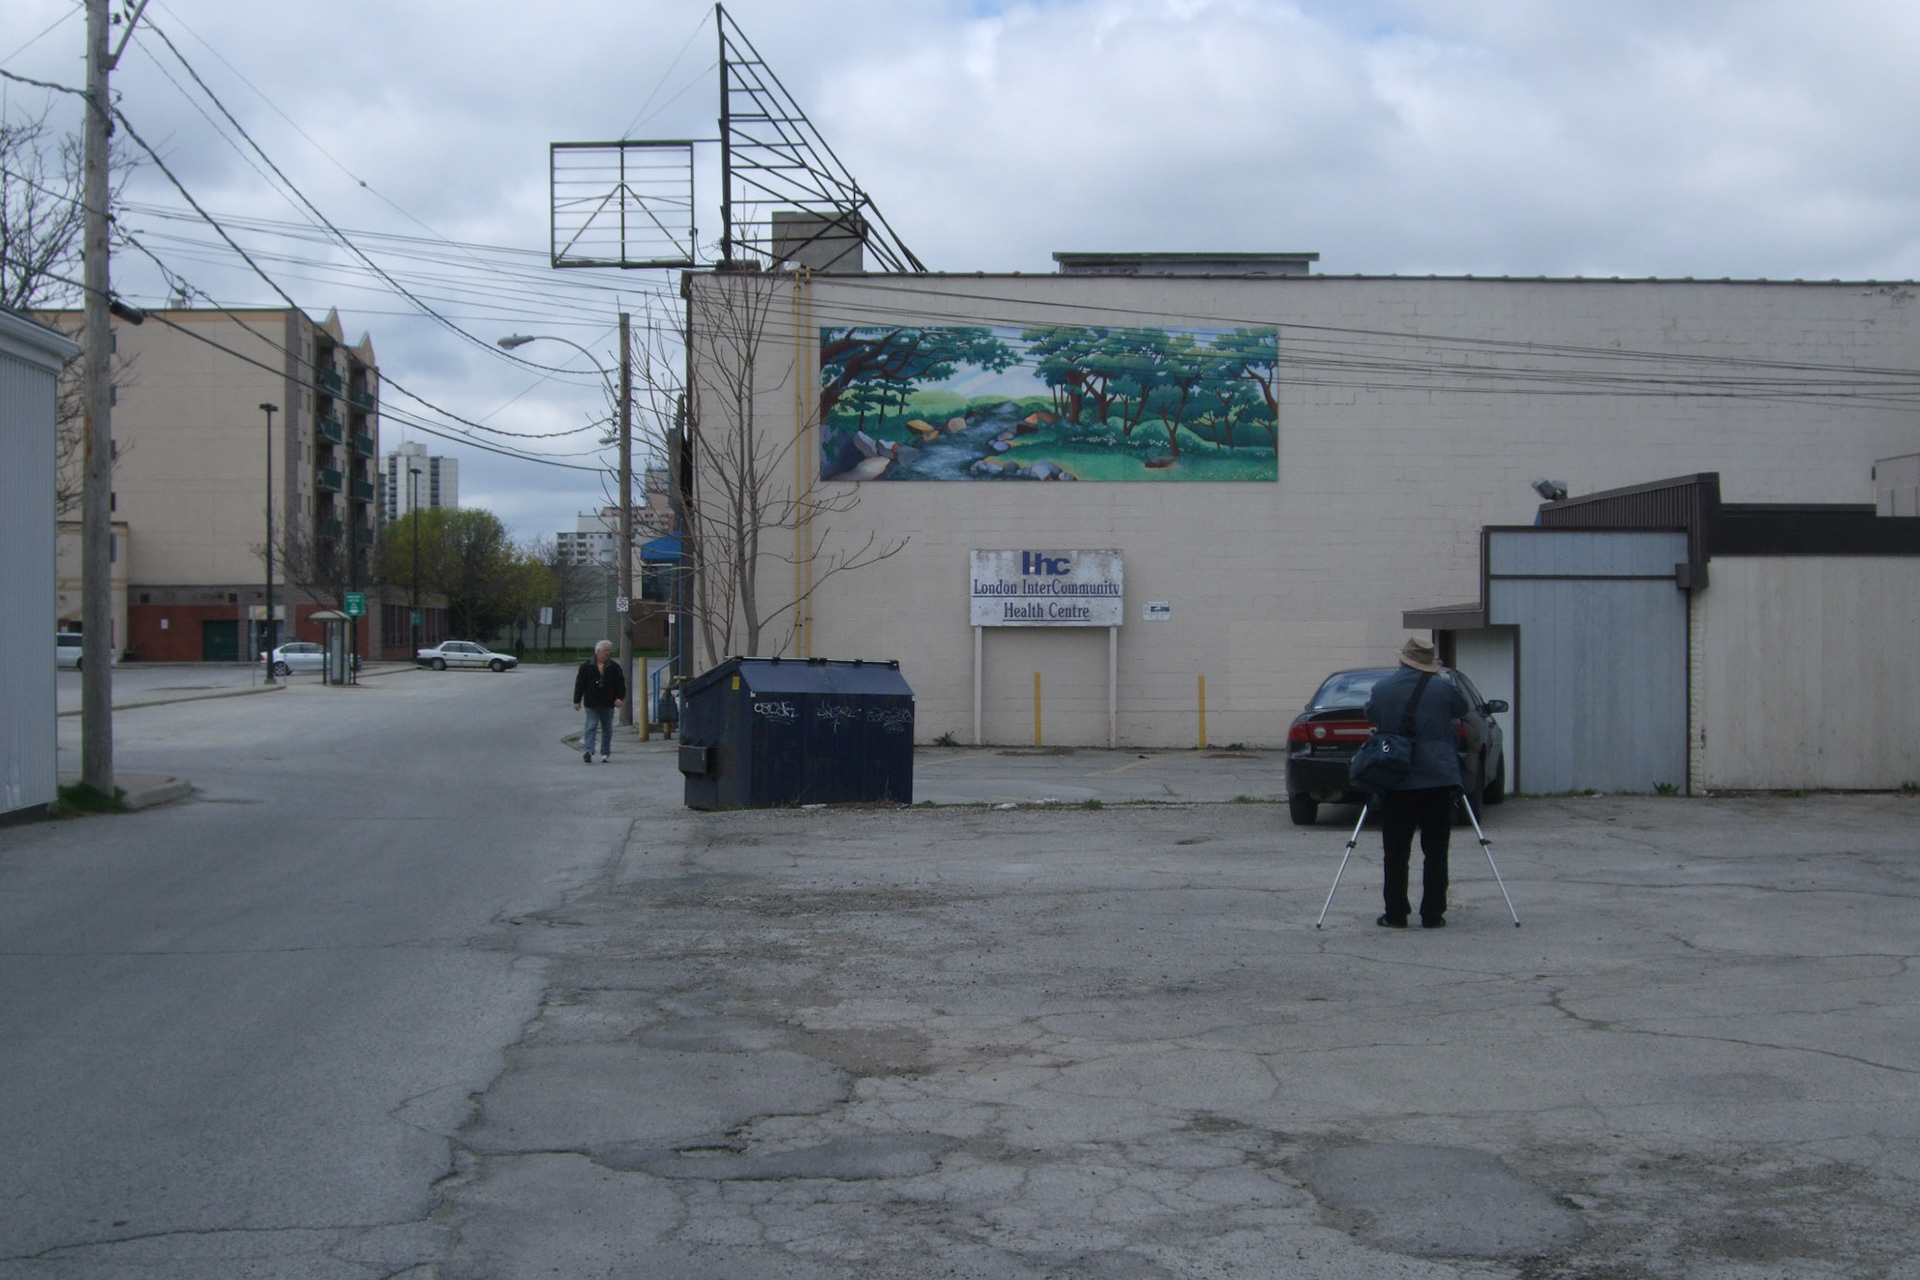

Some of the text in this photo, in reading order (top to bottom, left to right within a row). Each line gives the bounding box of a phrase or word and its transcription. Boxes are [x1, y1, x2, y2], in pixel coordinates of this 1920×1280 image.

[974, 579, 1120, 596] London InterCommunity
[1003, 602, 1090, 618] Health Centre
